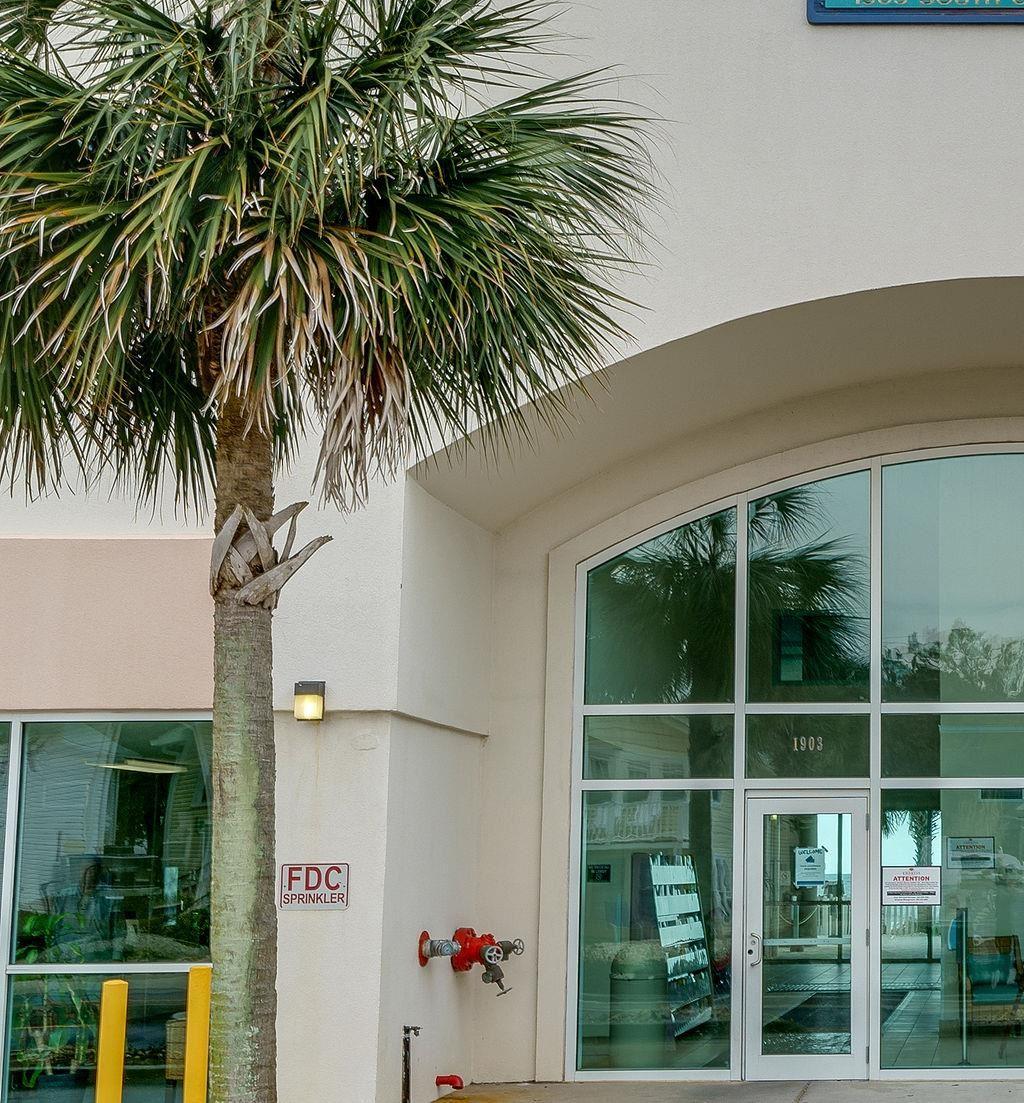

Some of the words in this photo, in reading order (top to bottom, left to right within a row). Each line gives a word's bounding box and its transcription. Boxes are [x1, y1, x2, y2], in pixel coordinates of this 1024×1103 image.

[792, 736, 823, 752] 1903
[287, 866, 342, 891] FDC
[282, 892, 345, 905] SPRINKLER
